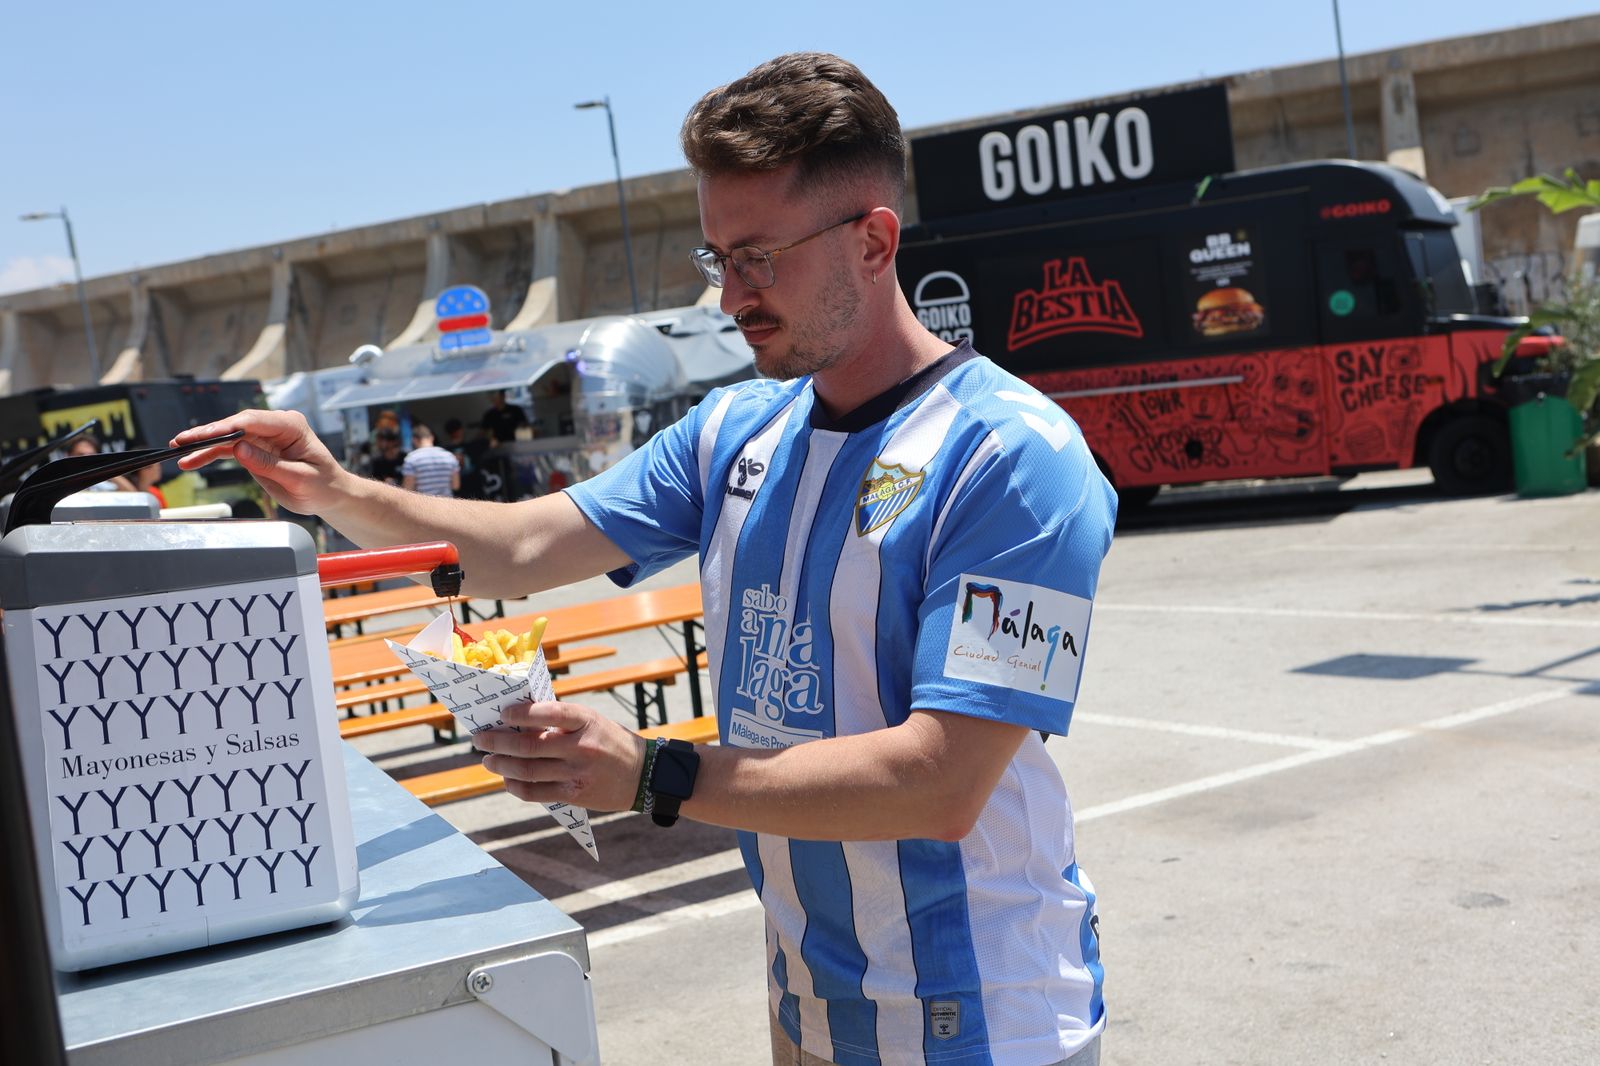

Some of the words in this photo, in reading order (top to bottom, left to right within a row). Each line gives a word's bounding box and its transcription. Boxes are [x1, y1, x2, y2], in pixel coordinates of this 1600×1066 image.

[979, 107, 1154, 201] GOIKO
[1189, 242, 1251, 263] QUEEN
[1045, 257, 1092, 291] LA
[917, 303, 971, 330] GOIKO
[1013, 281, 1139, 333] BESTIA
[1335, 347, 1385, 384] SAY
[1340, 374, 1425, 412] CHEESE
[744, 586, 788, 612] sabo
[962, 582, 1077, 688] Málaga
[953, 645, 1000, 662] Ciudad
[1007, 655, 1042, 672] Genial
[732, 722, 760, 744] Málaga
[760, 734, 770, 747] es
[60, 747, 197, 780] Mayonesas
[204, 744, 218, 764] y
[225, 730, 300, 756] Salsas
